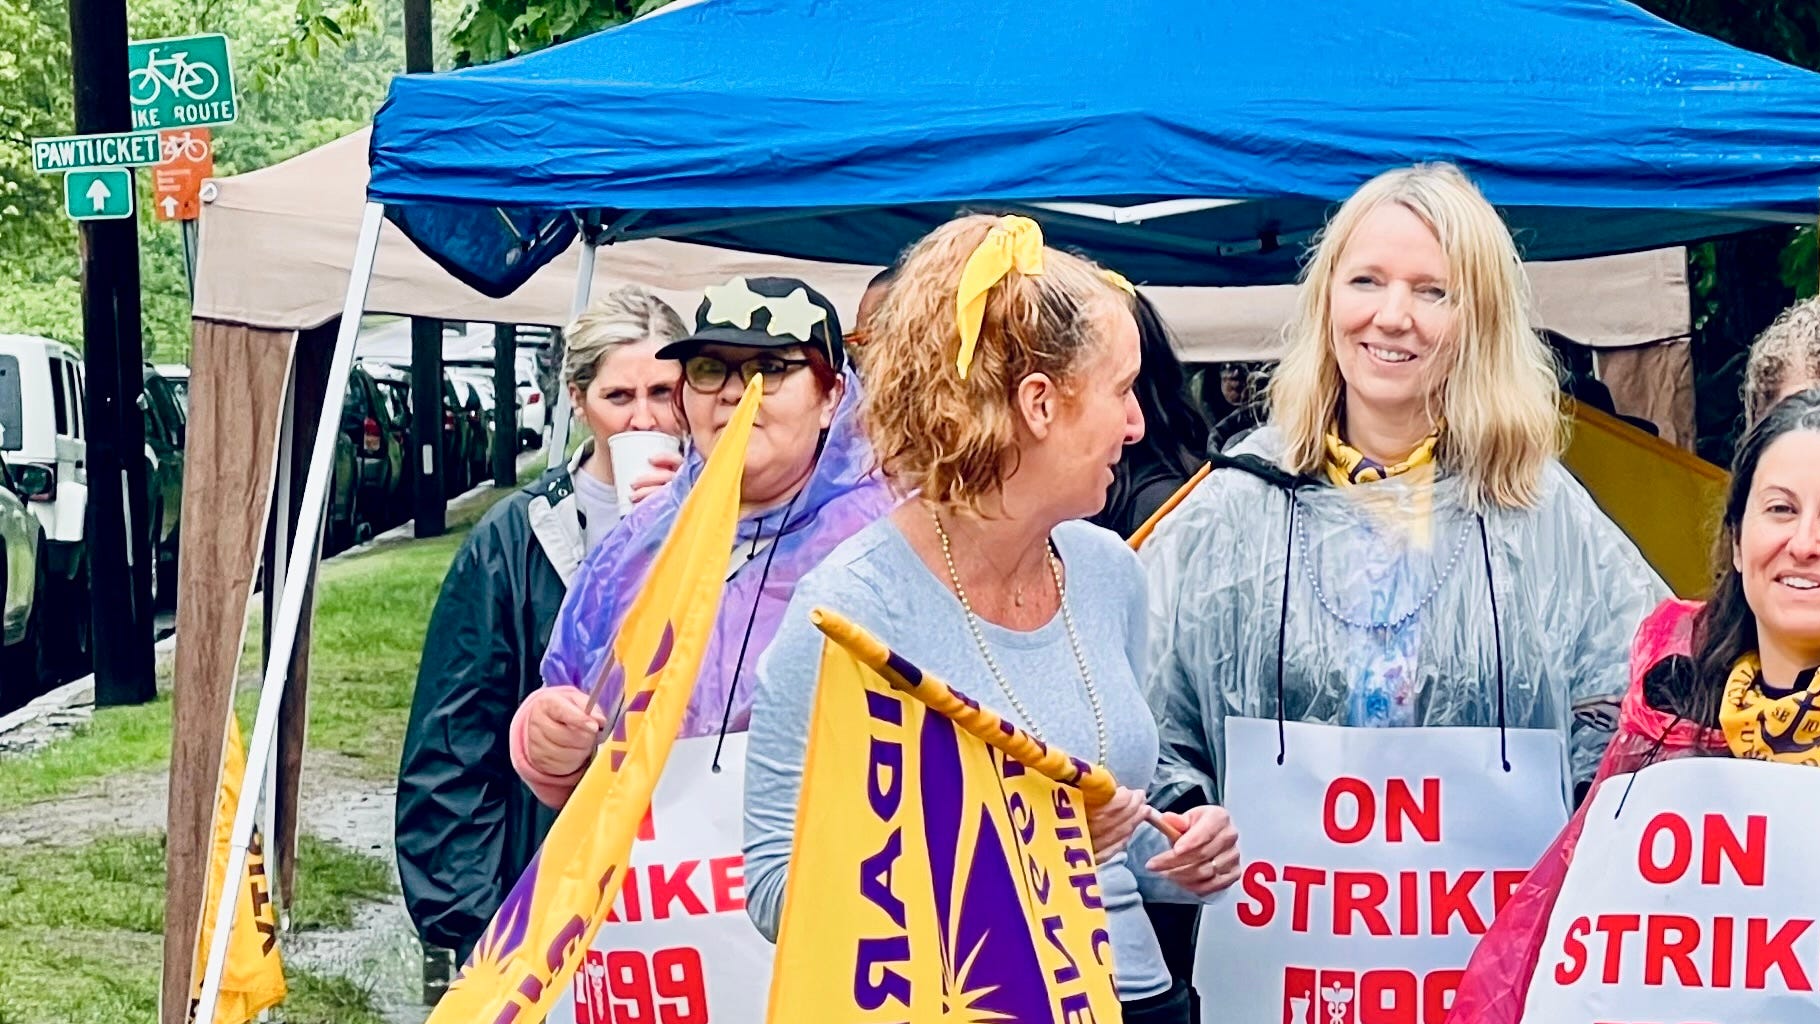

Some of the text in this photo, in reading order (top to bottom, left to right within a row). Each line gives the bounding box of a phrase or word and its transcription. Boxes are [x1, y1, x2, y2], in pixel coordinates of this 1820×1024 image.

[132, 100, 233, 128] IKE ROUTE
[37, 134, 157, 169] PAWTUCKET
[1324, 777, 1441, 844] ON
[1639, 812, 1768, 887] ON
[622, 855, 746, 923] IKE
